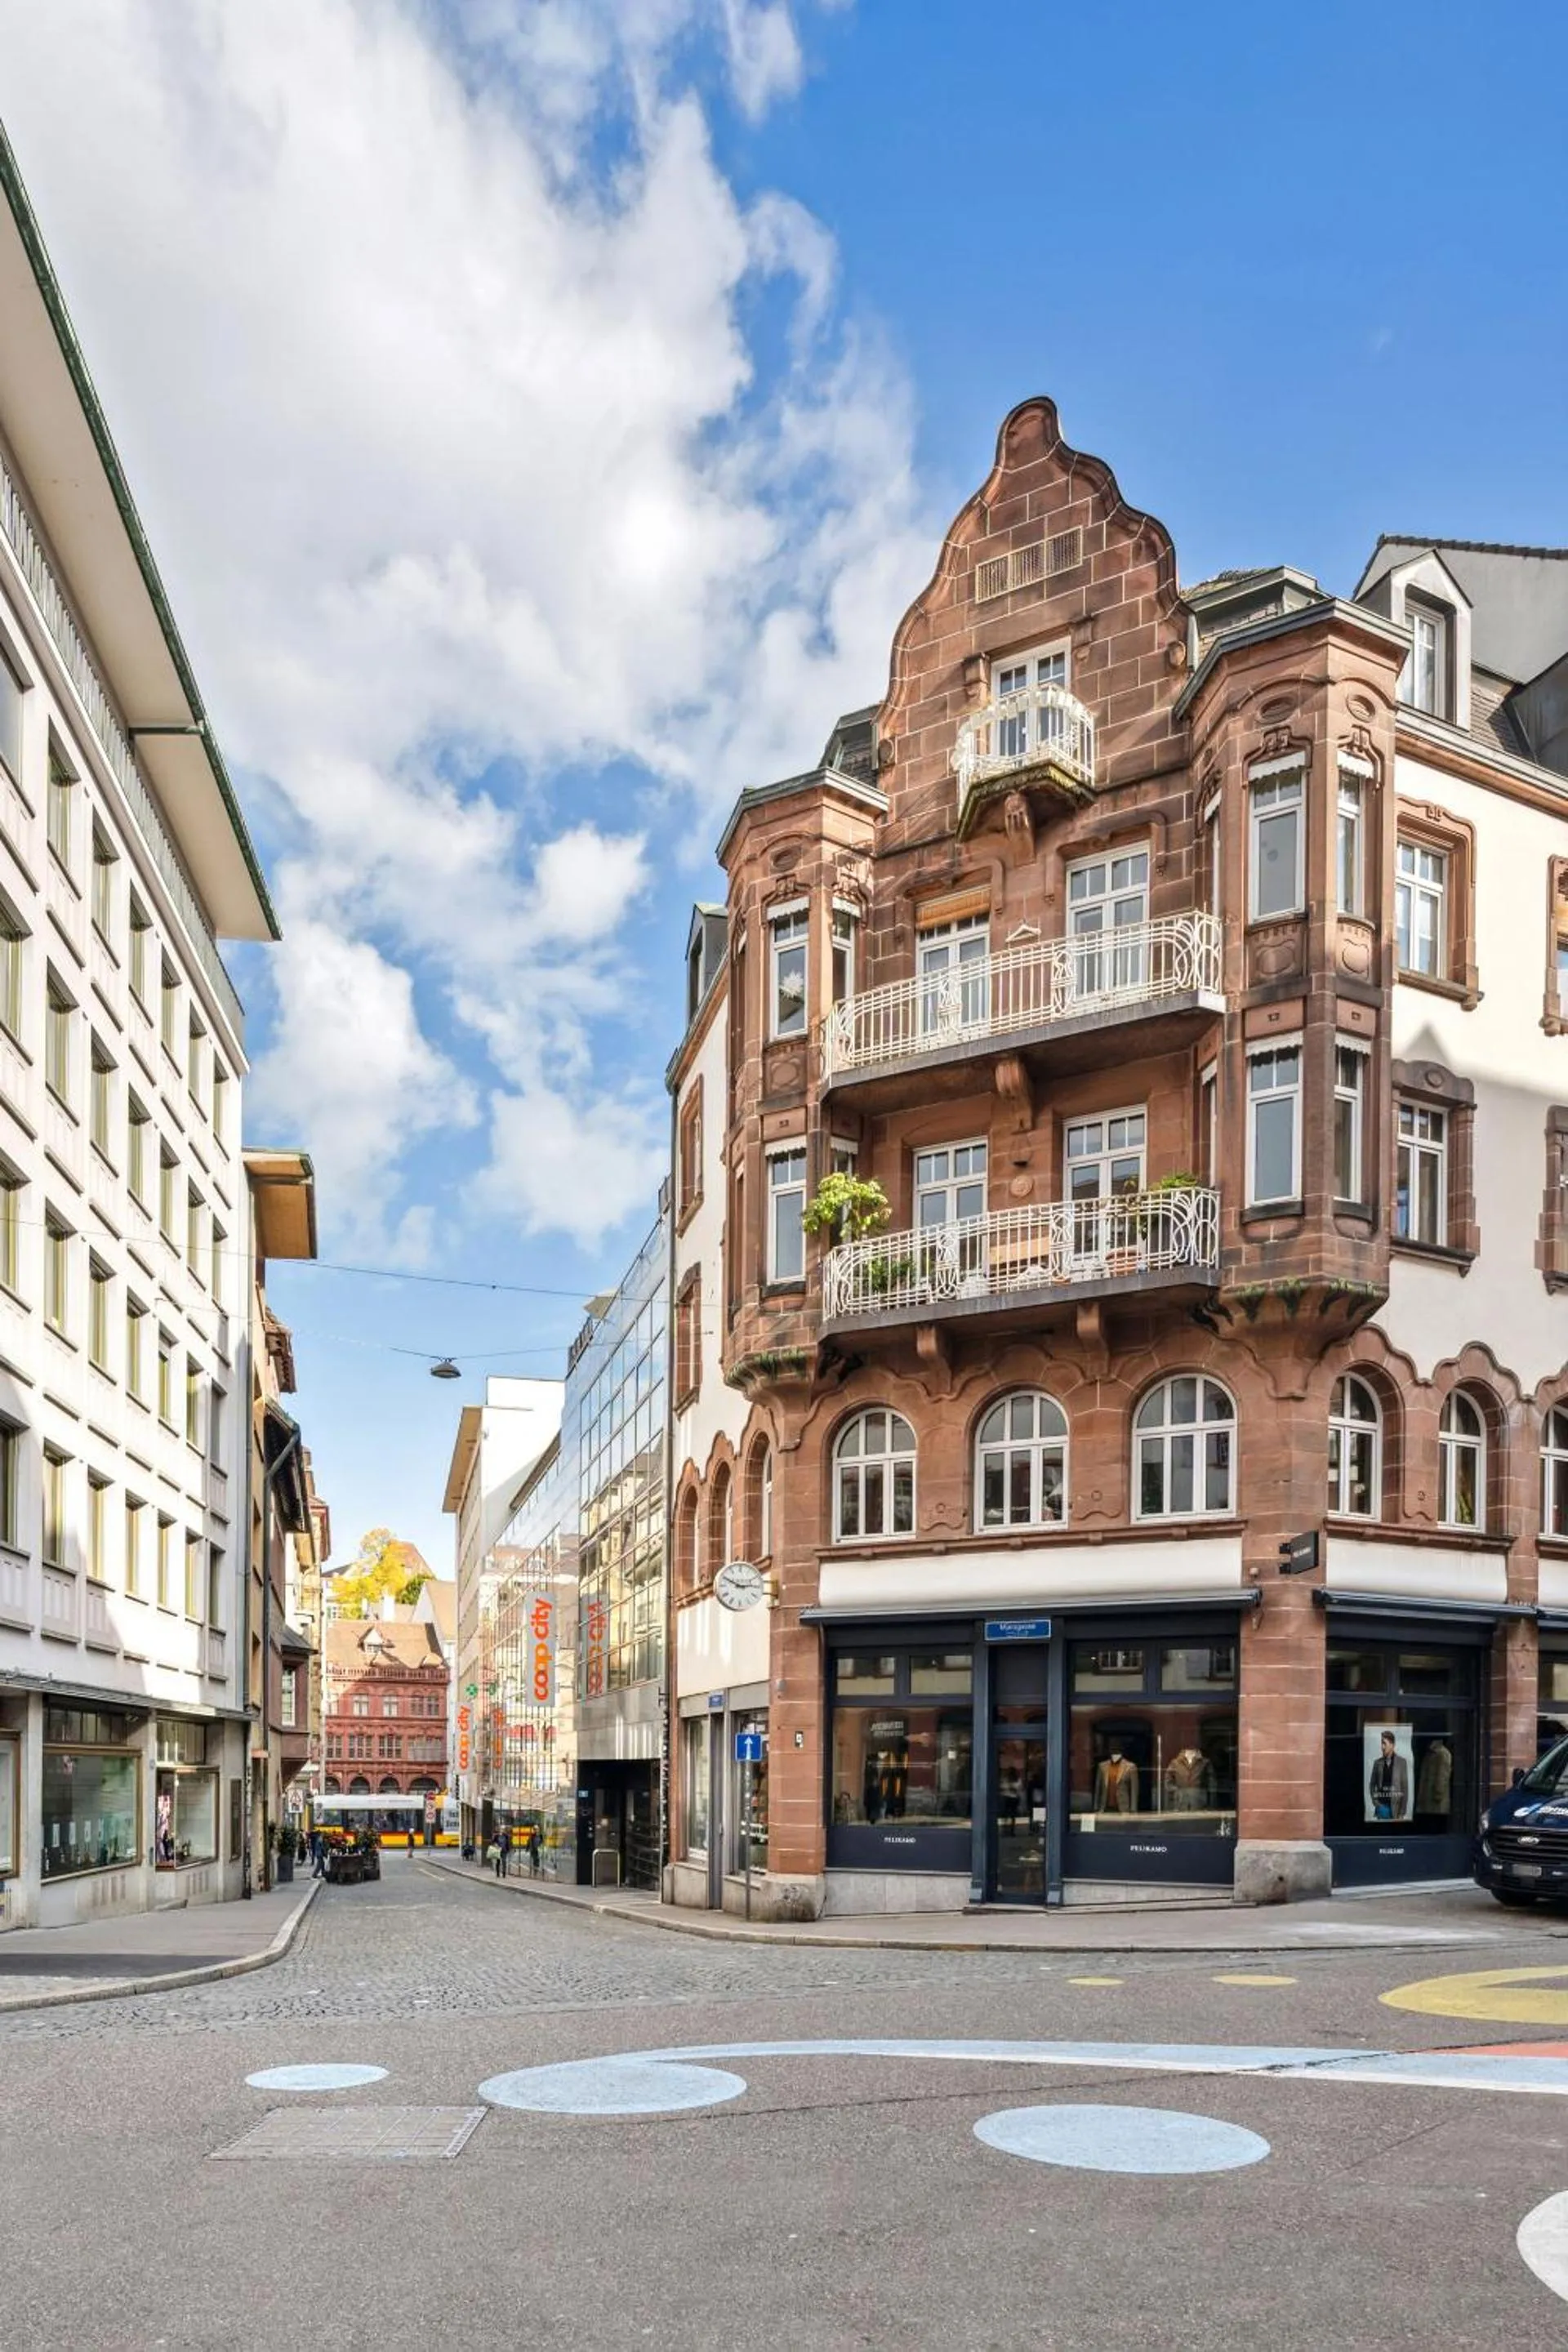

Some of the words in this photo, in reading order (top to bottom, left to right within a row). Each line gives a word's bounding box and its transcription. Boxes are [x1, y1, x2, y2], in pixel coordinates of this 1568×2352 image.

[531, 1597, 552, 1641] city
[534, 1642, 553, 1701] coop
[457, 1704, 471, 1731] city
[460, 1733, 470, 1771] coop
